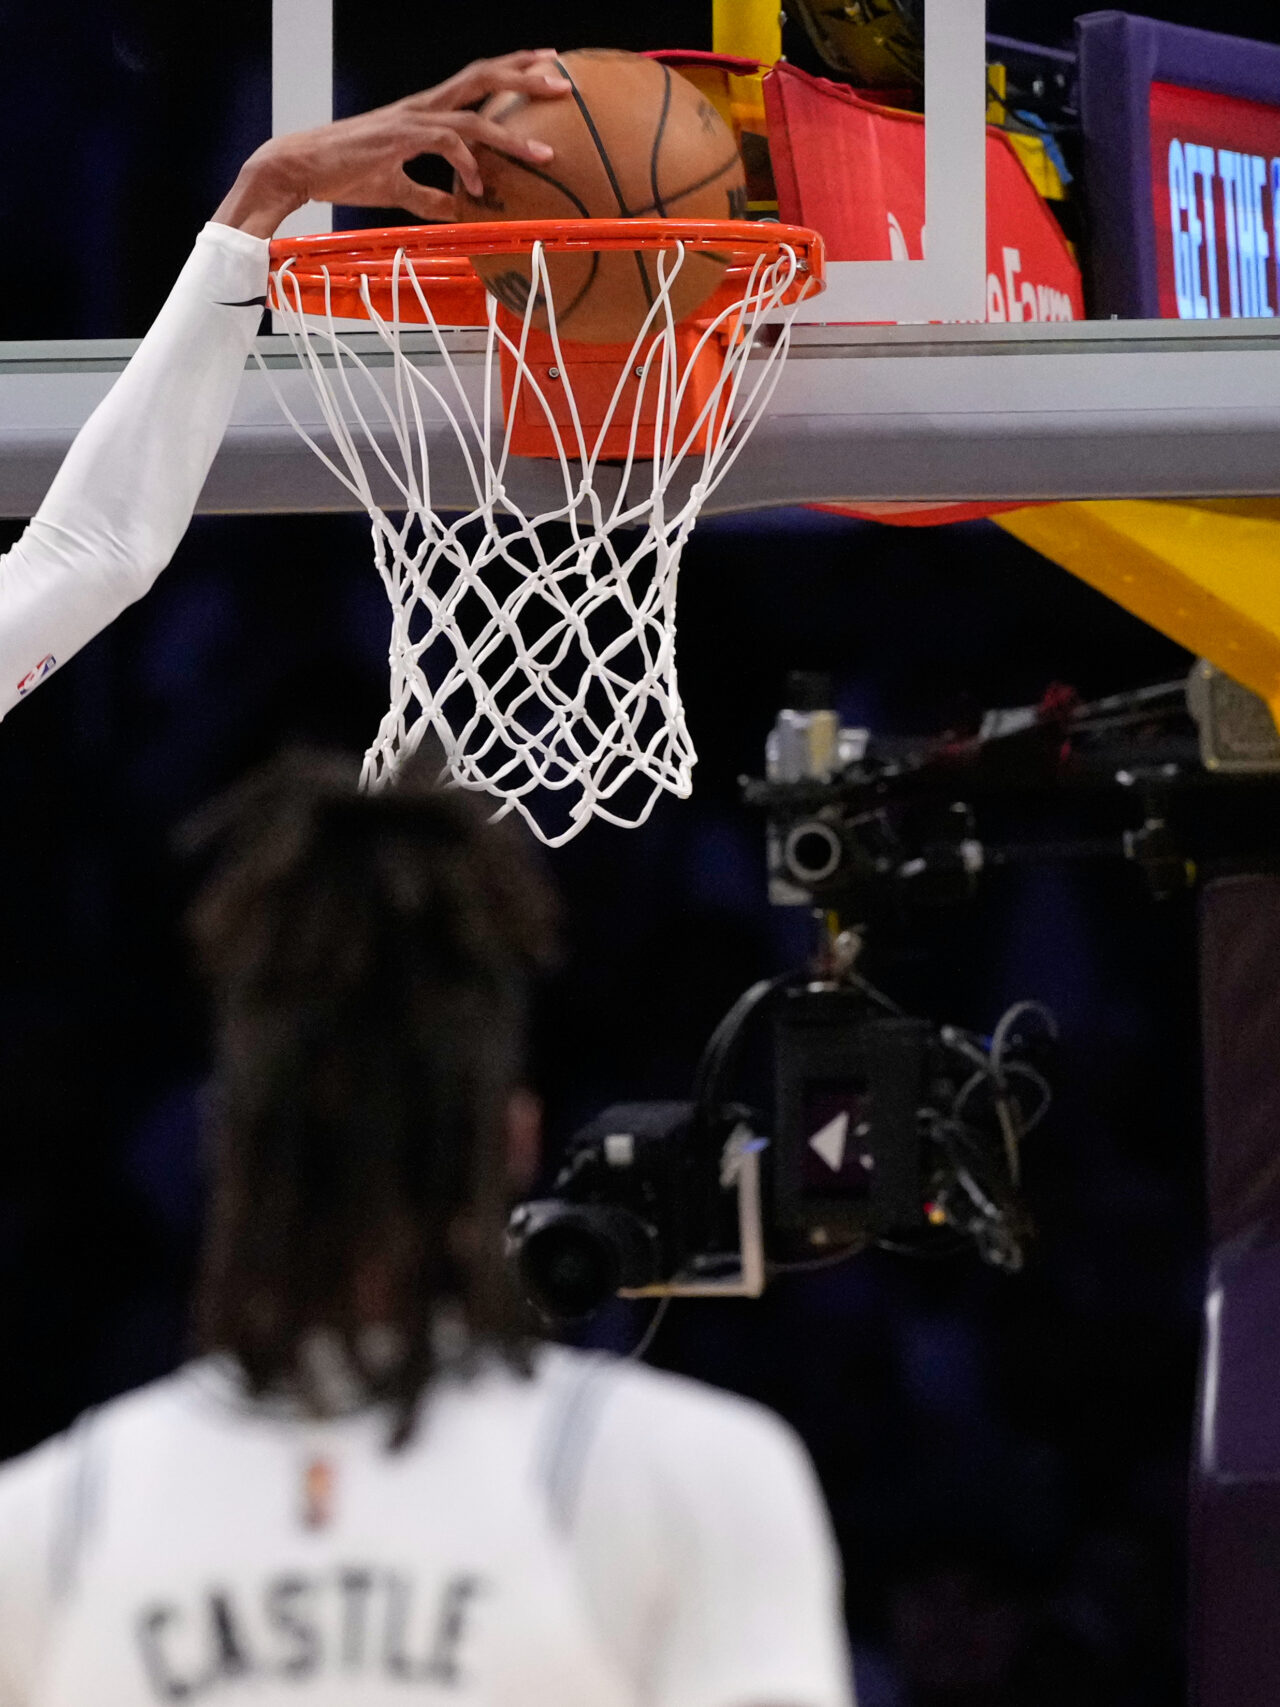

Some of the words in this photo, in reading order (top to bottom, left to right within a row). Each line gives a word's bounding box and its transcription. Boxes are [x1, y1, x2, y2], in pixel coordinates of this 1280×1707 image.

[1169, 138, 1219, 319] GET
[1218, 149, 1274, 318] THE
[136, 1564, 487, 1698] CASTLE
